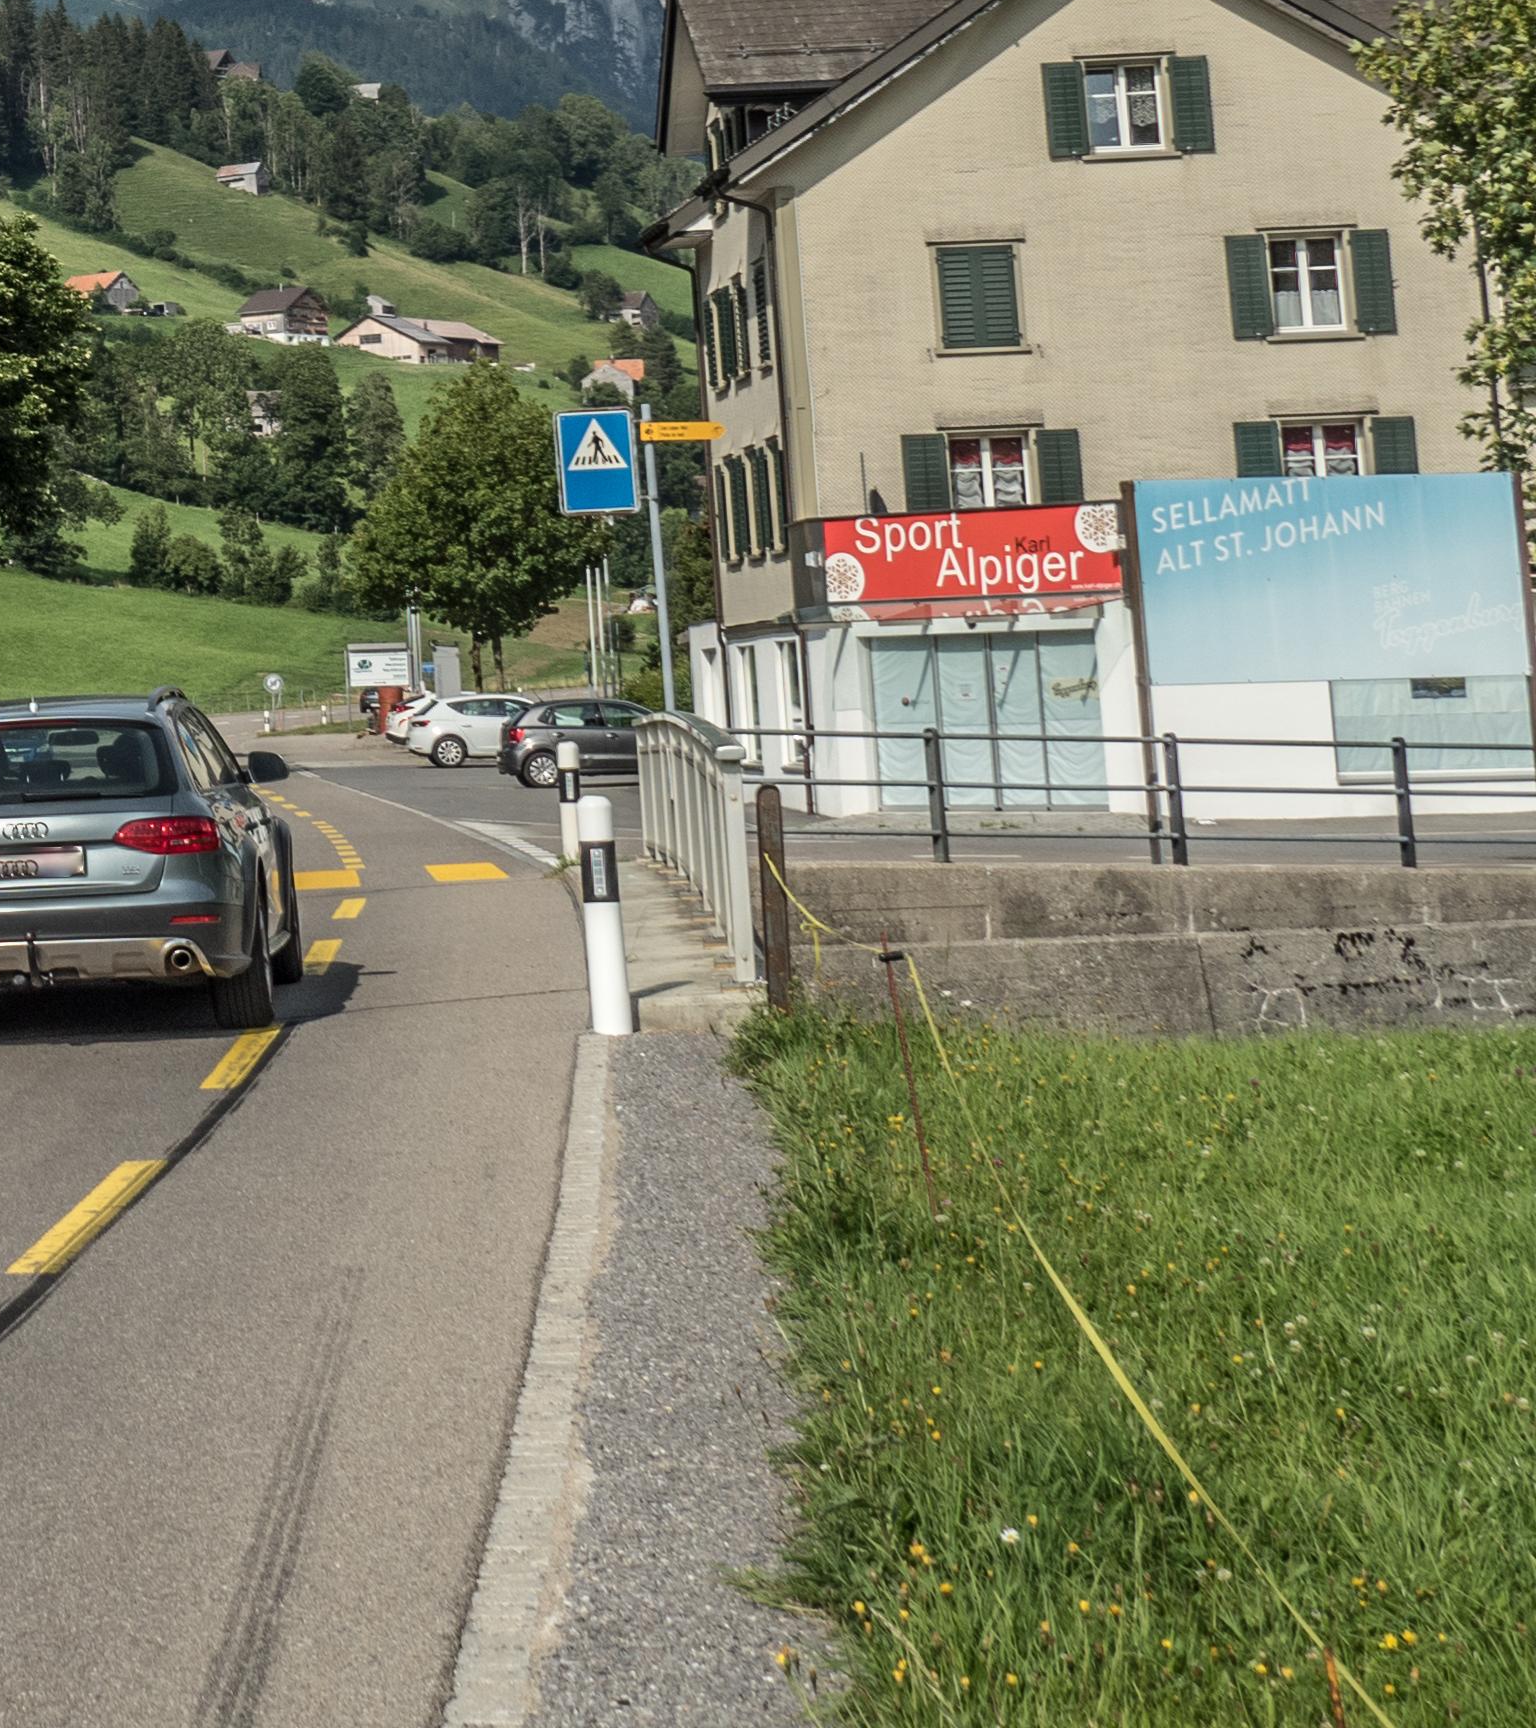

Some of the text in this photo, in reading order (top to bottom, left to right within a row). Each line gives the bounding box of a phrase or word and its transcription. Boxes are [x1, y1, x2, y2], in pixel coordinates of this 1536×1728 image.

[1151, 476, 1311, 534] SELLAMATT
[854, 512, 964, 562] Sport
[1014, 535, 1051, 554] Karl
[1156, 500, 1385, 575] ALT ST. JOHANN
[935, 543, 1085, 595] Alpiger
